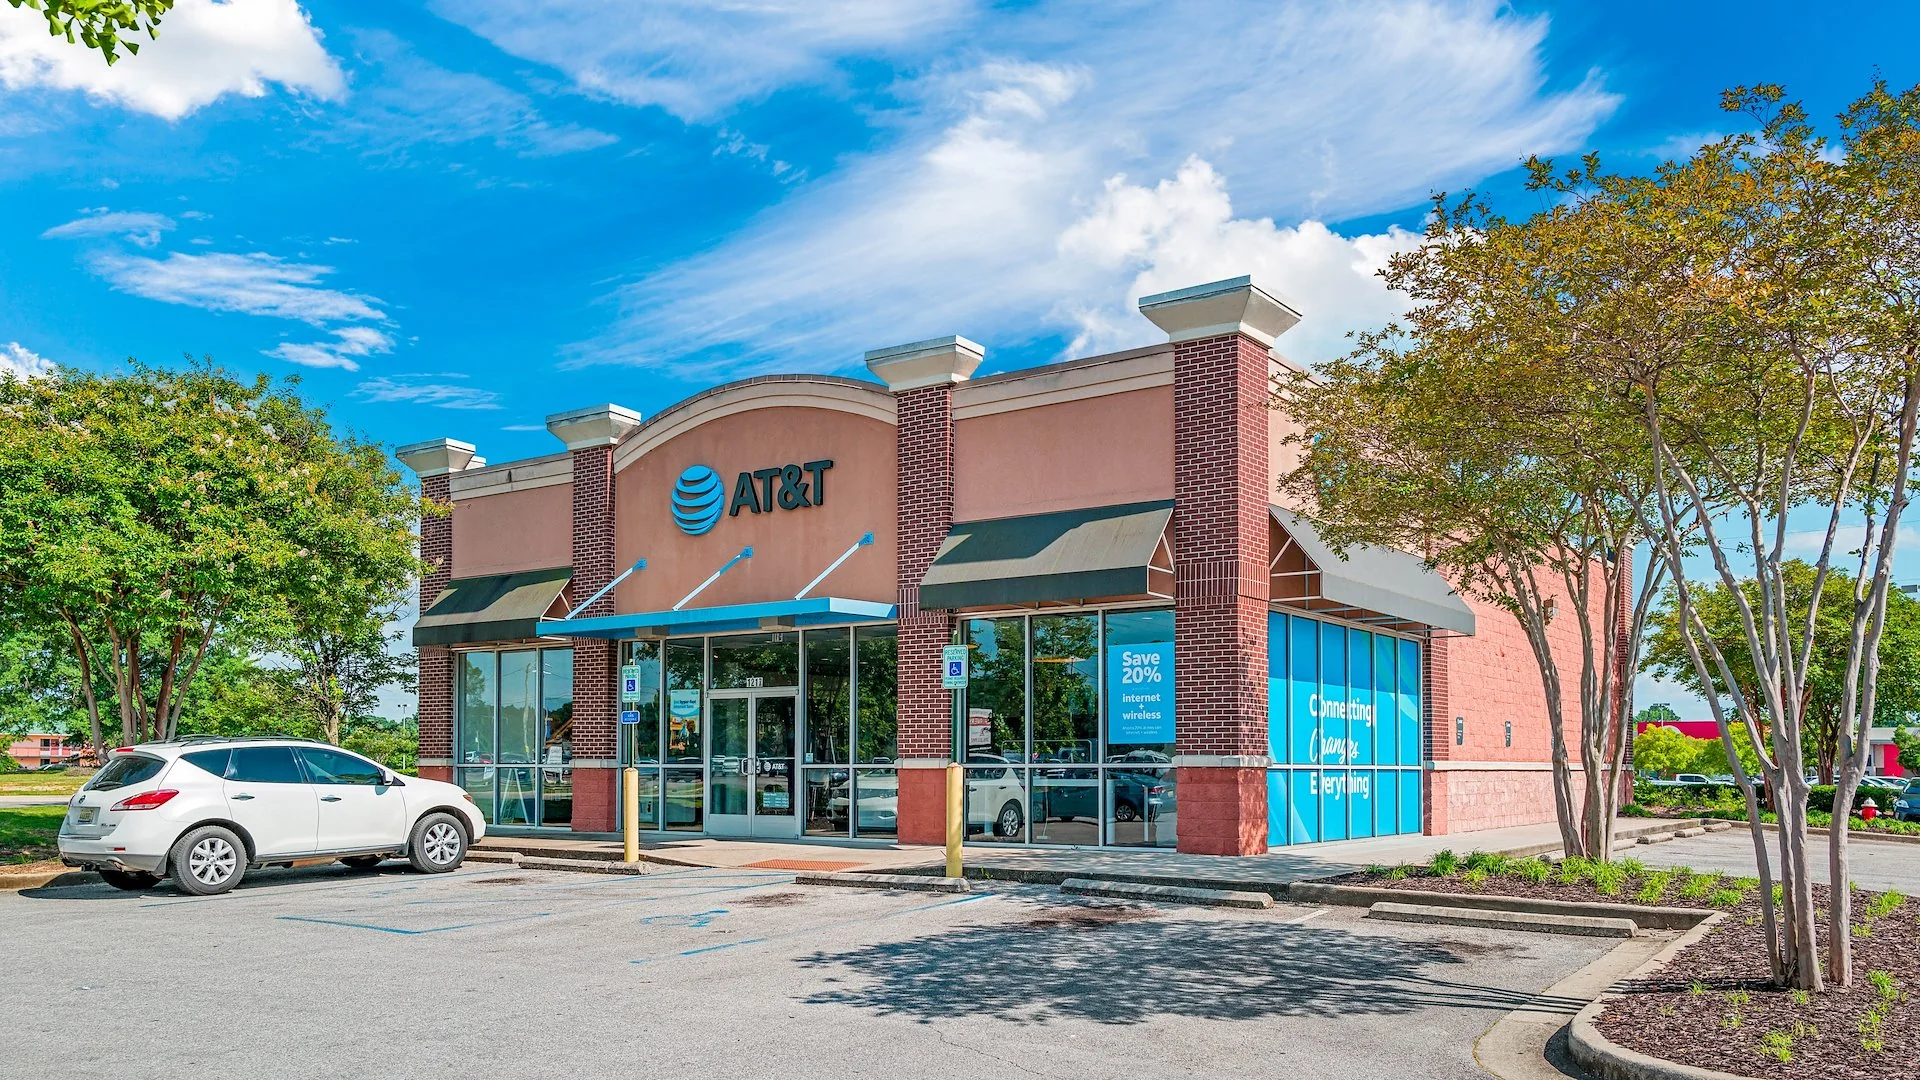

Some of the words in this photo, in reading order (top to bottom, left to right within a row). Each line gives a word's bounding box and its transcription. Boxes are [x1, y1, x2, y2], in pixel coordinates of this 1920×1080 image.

[729, 460, 834, 516] AT&T
[1122, 651, 1161, 667] Save
[1121, 665, 1162, 684] 20%
[1122, 693, 1161, 703] internet
[1122, 710, 1161, 720] wireless
